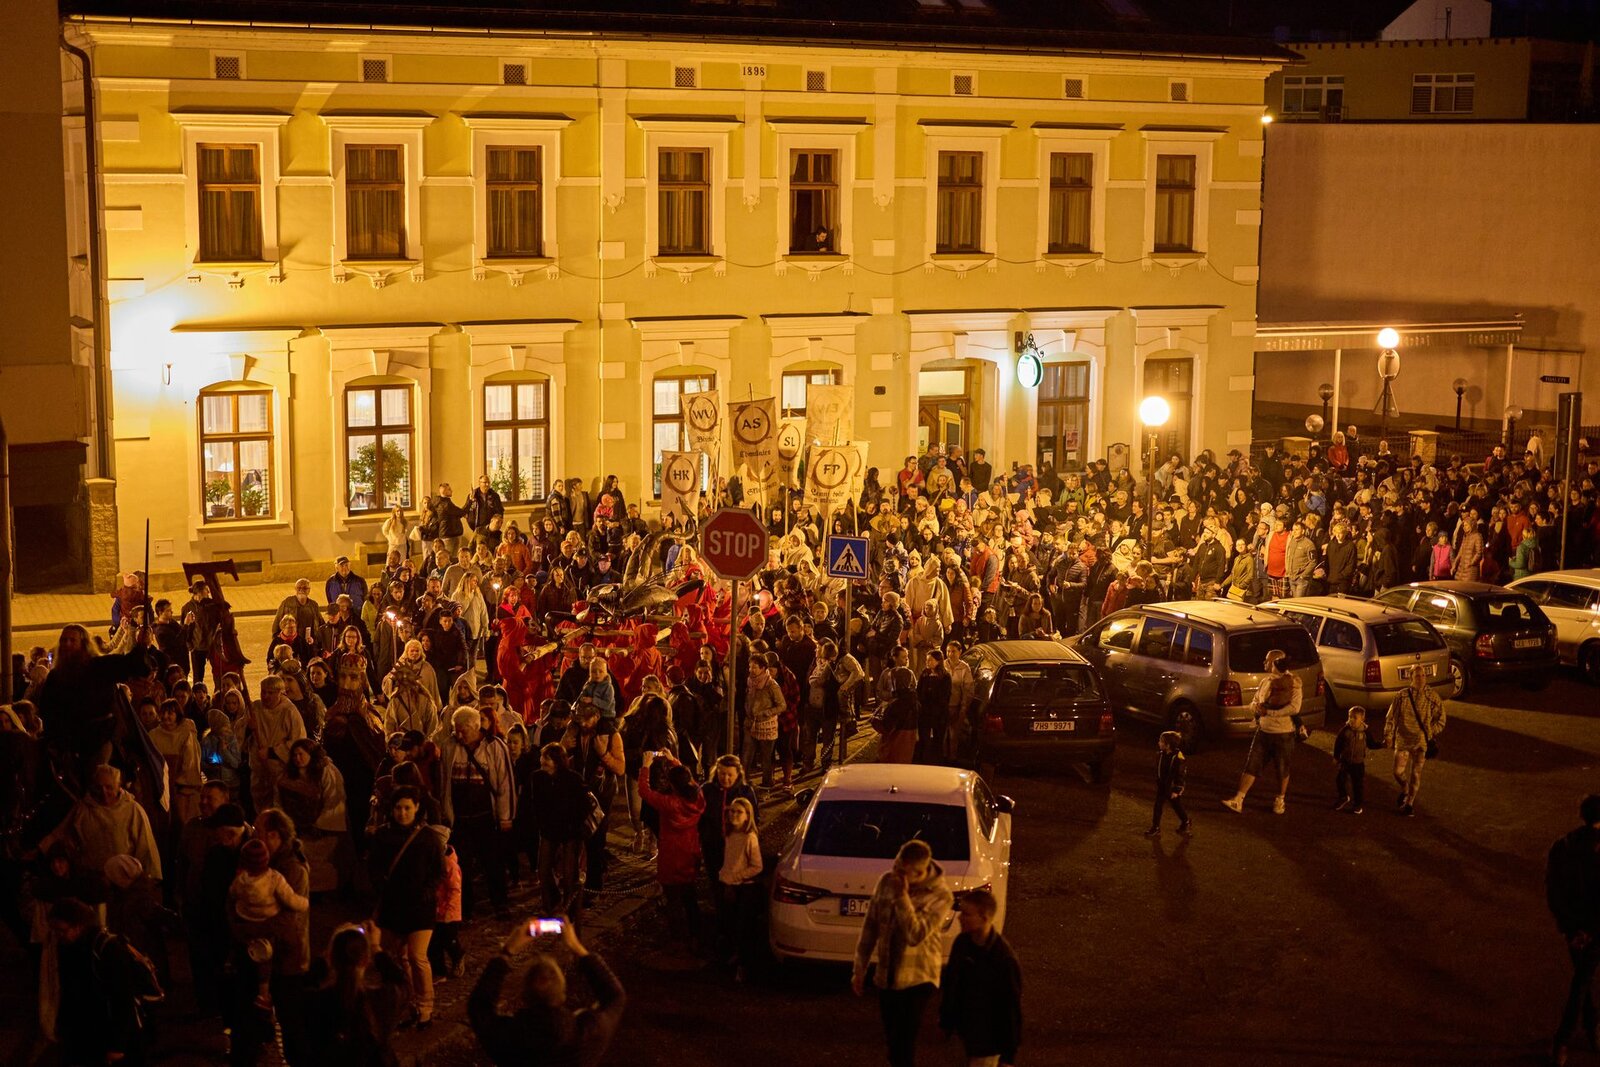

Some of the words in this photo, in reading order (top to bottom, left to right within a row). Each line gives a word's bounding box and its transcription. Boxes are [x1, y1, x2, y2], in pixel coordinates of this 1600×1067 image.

[743, 66, 765, 76] 1898
[742, 418, 761, 430] AS
[784, 436, 795, 447] SL
[673, 469, 690, 481] HK
[823, 464, 840, 475] FP
[709, 530, 760, 558] STOP
